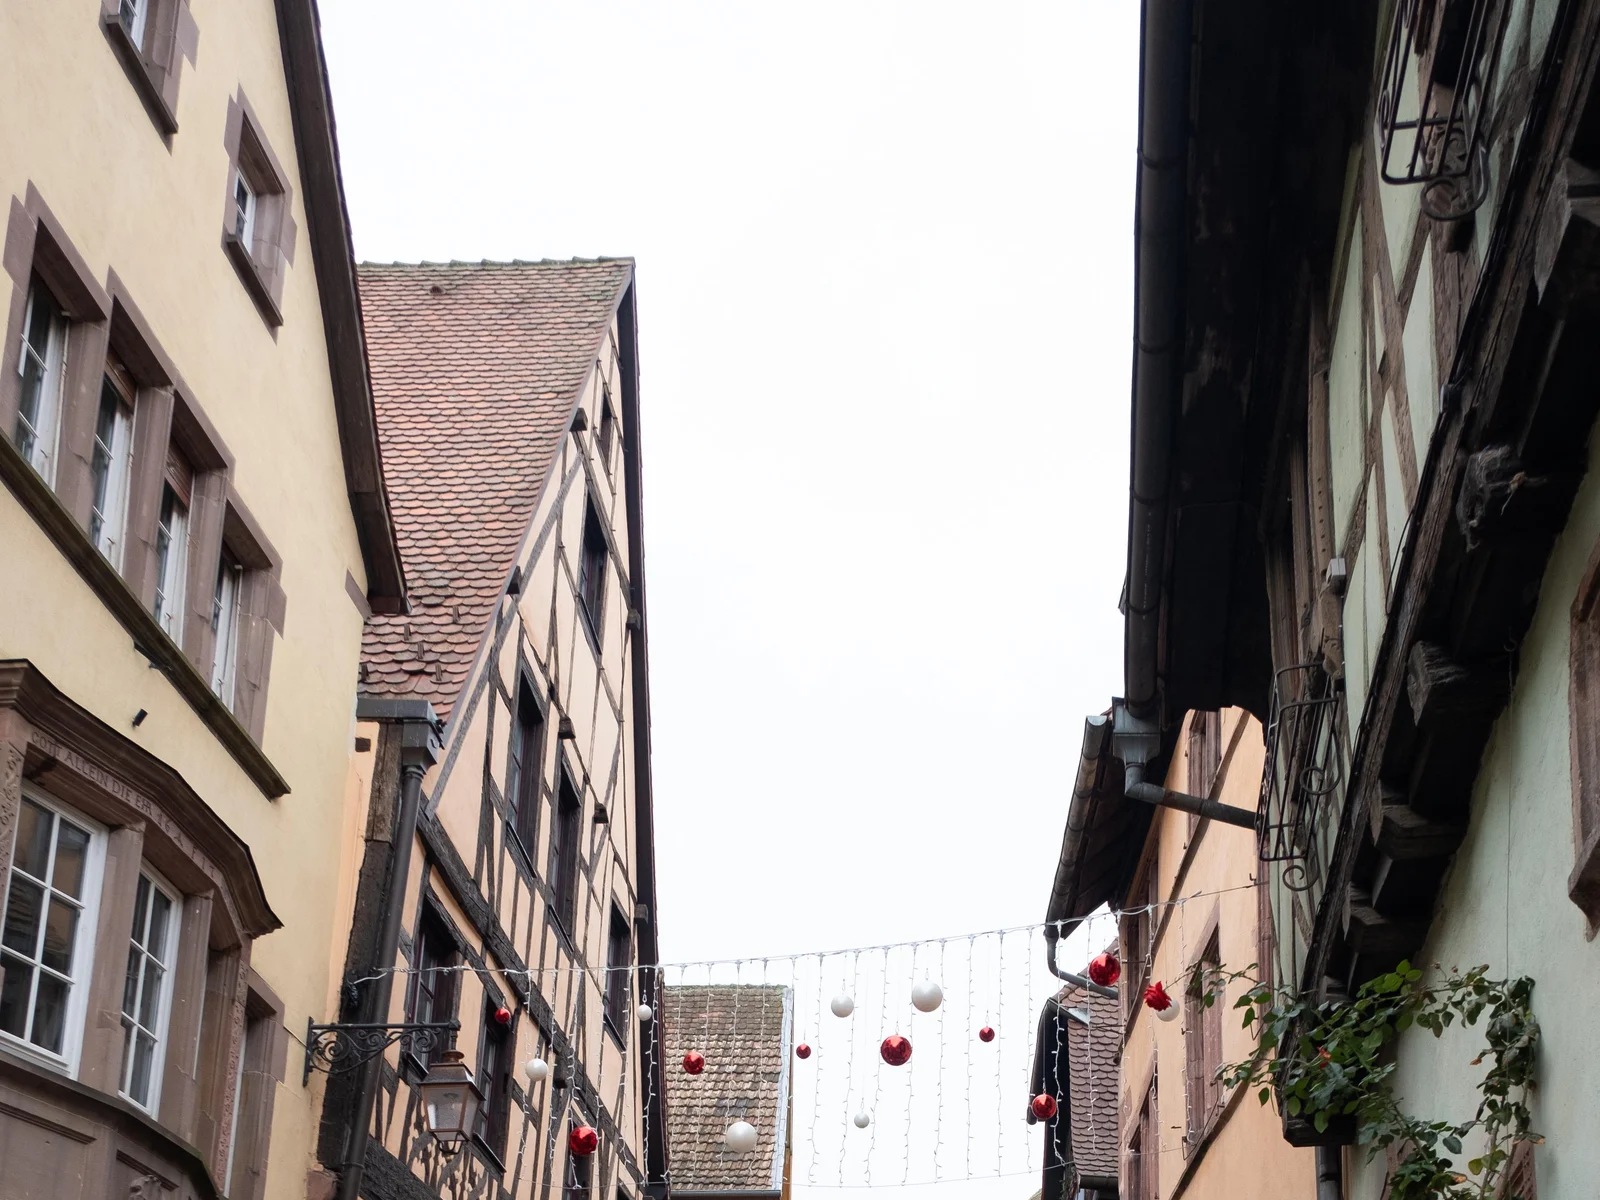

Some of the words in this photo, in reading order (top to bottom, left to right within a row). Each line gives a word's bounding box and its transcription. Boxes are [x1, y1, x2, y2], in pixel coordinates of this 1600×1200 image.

[31, 731, 62, 757] GOTT
[64, 751, 109, 787] ALLEIN
[112, 781, 132, 802] DIE
